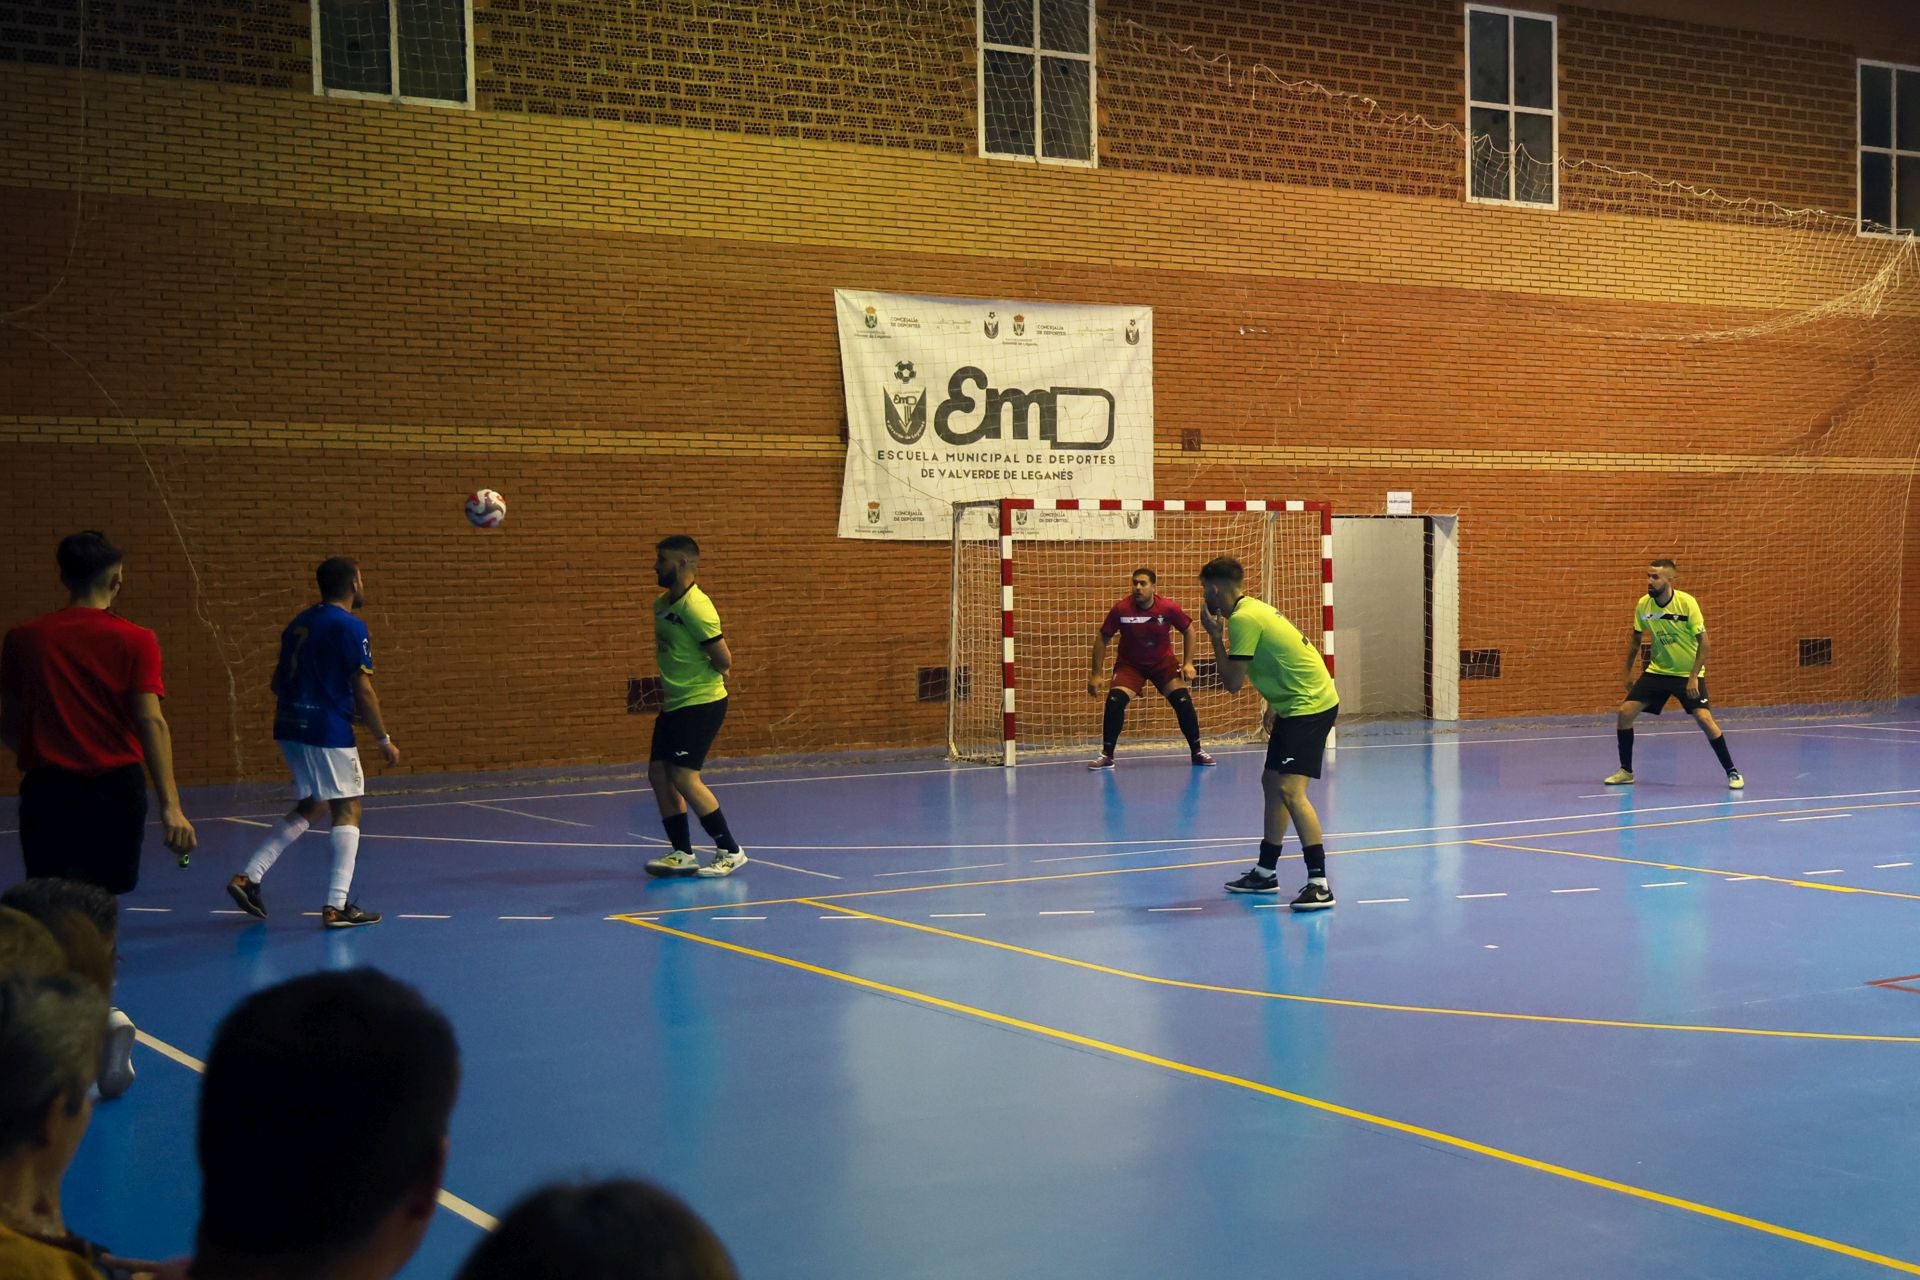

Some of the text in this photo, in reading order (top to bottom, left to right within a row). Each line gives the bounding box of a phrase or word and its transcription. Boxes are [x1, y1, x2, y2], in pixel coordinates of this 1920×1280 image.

[877, 450, 1116, 465] ESCUELA MUNICIPAL DE DEPORTES
[921, 468, 1074, 481] DE VALVERDE DE LEGANÉS
